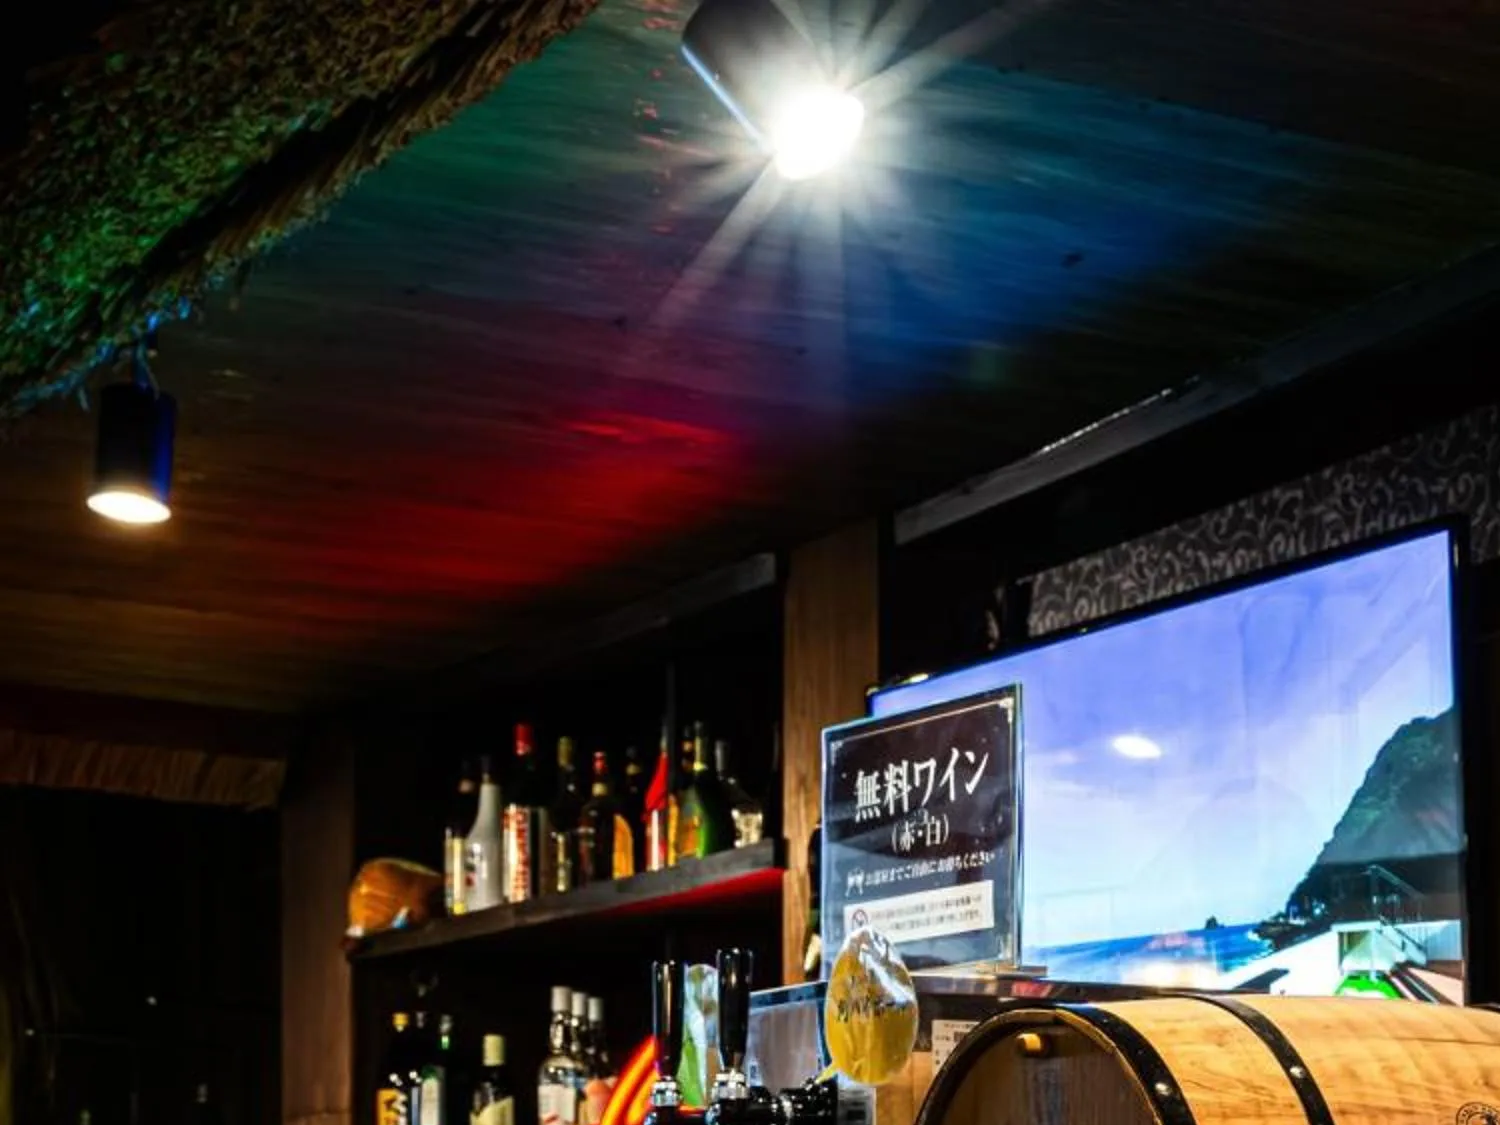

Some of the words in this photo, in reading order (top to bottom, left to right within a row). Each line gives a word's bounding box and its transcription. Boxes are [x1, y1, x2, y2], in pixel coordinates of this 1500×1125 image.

[855, 747, 989, 822] 無料ワイン
